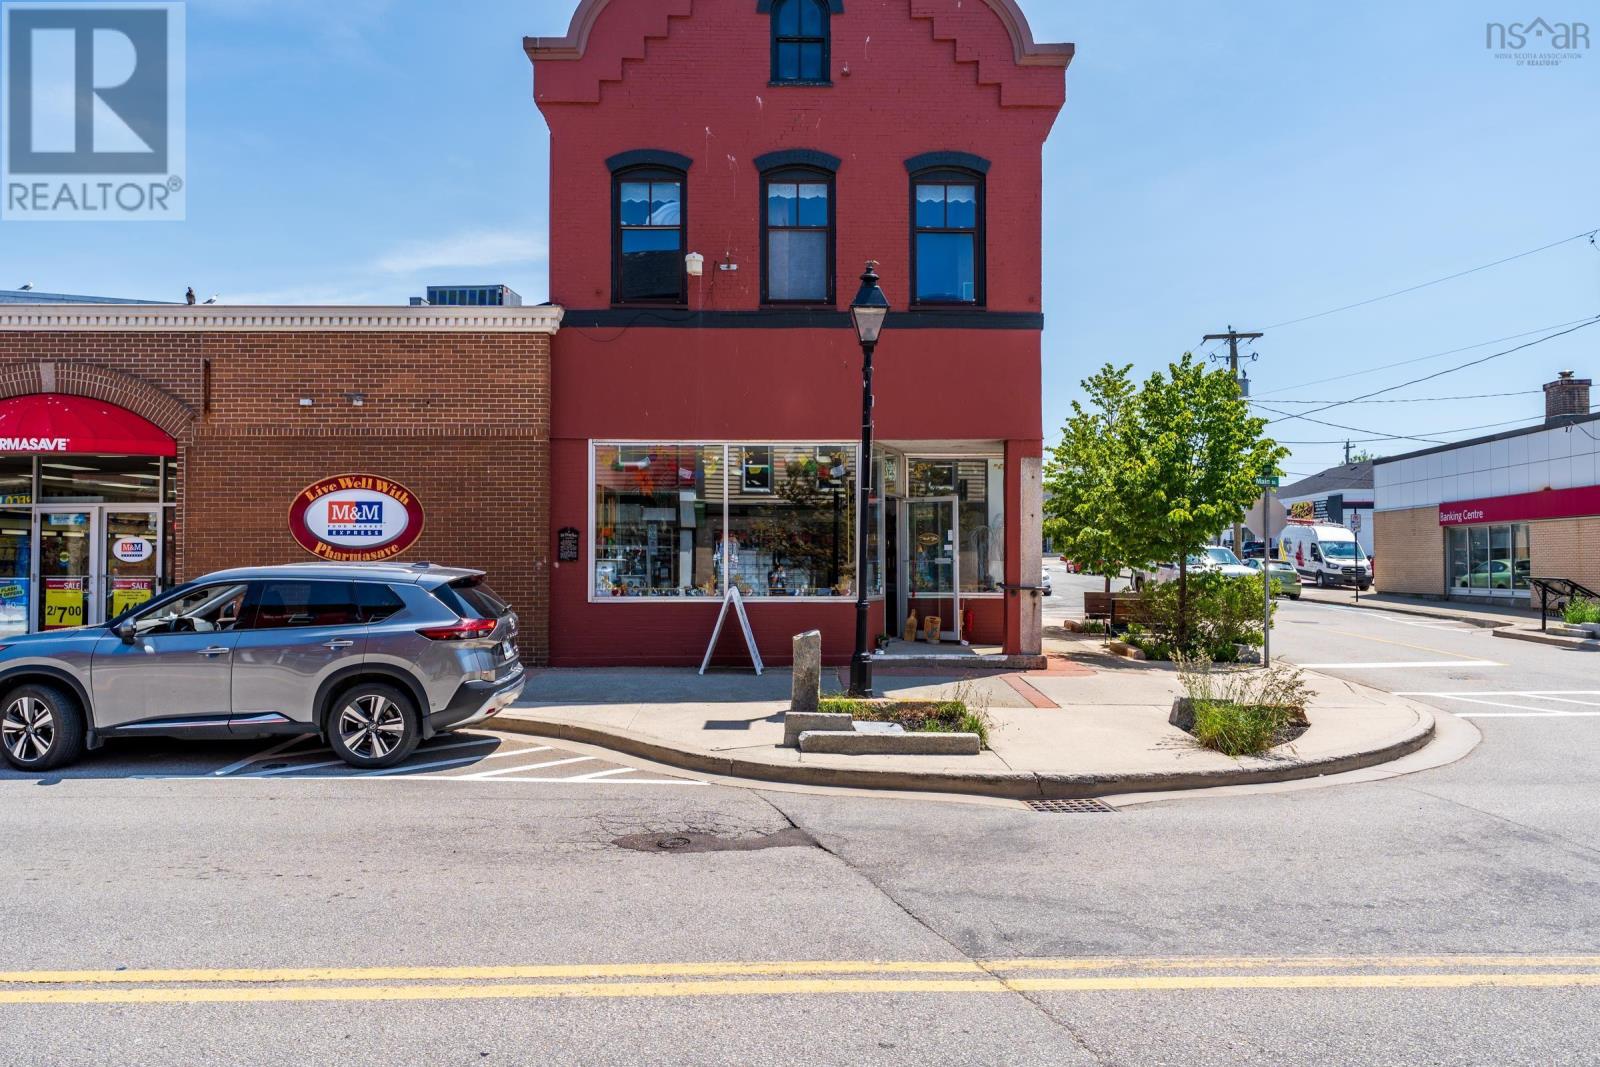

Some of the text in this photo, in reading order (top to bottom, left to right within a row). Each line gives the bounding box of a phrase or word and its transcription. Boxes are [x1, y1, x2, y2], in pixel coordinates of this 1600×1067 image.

[305, 477, 409, 505] Live Well With
[331, 504, 380, 520] M&M
[1440, 509, 1484, 523] Banking Centre
[122, 543, 142, 551] M&M
[314, 541, 400, 561] Pharmasave
